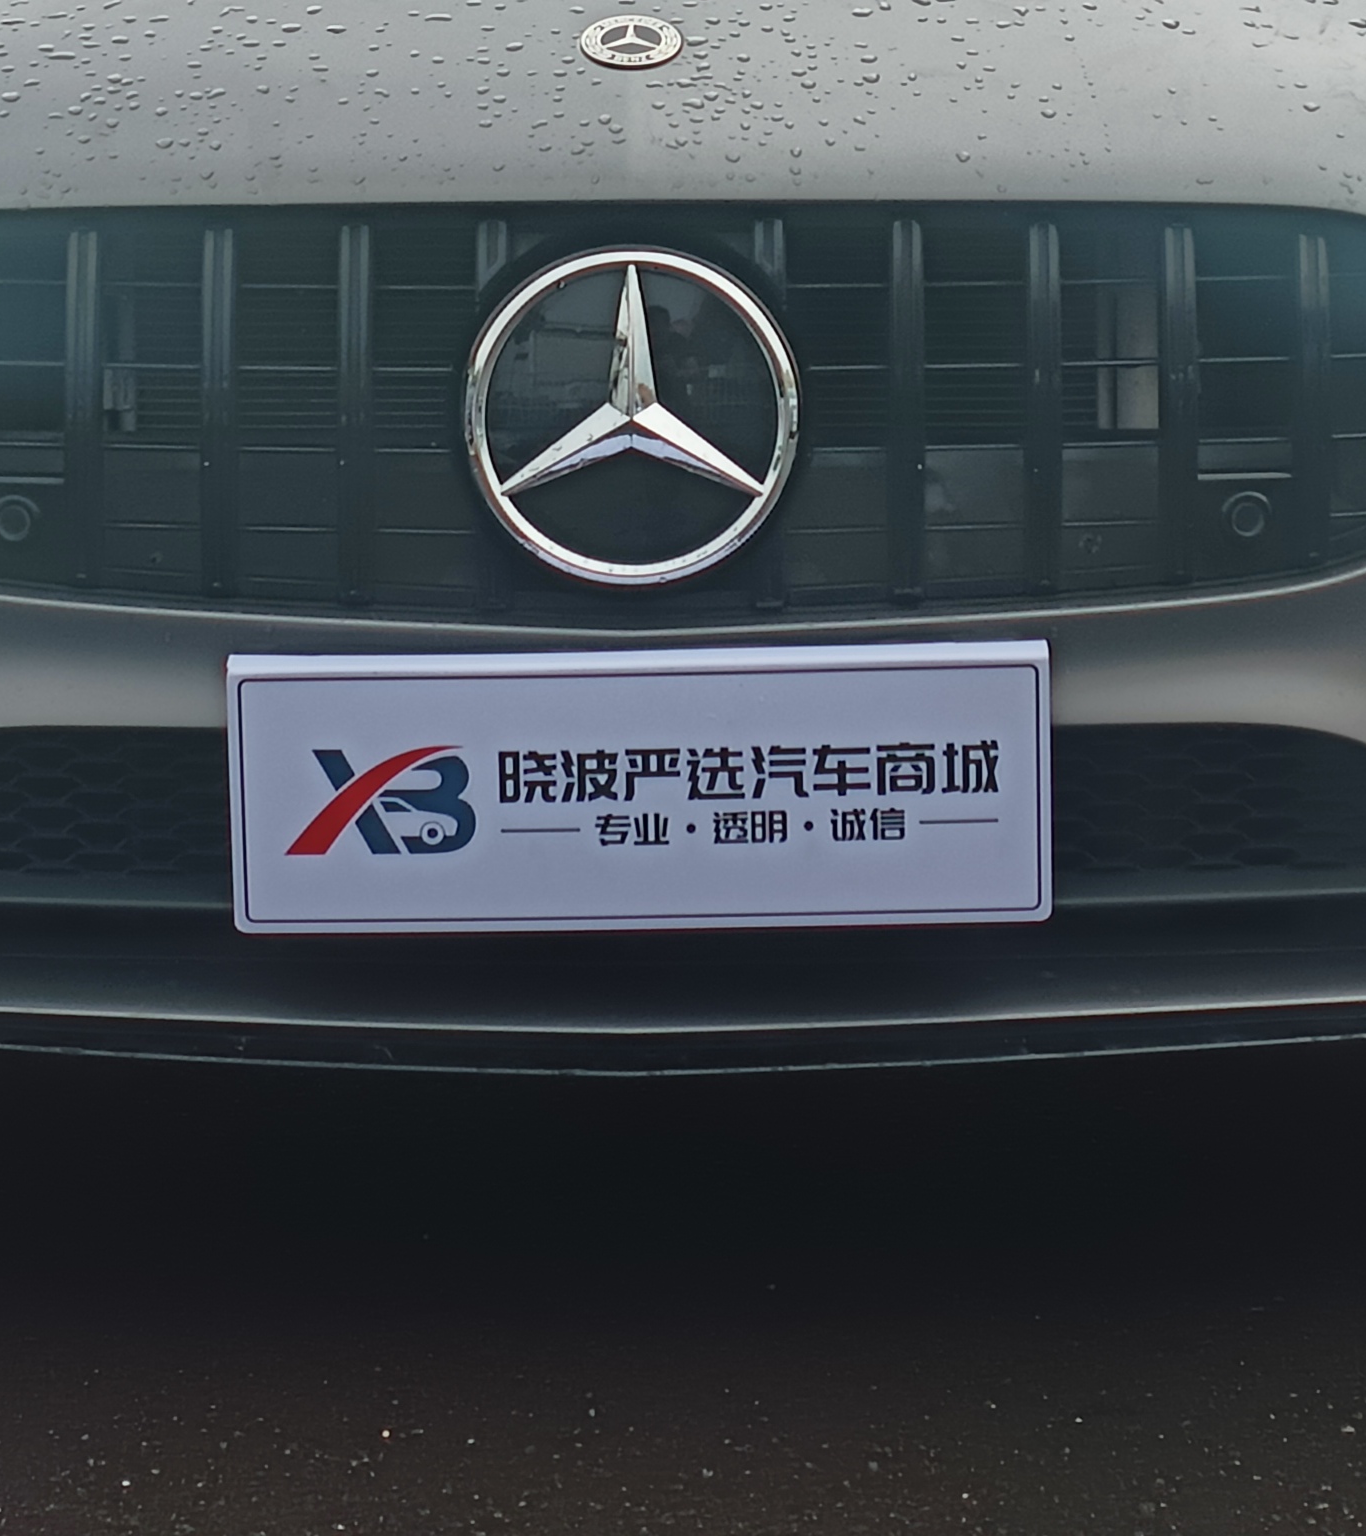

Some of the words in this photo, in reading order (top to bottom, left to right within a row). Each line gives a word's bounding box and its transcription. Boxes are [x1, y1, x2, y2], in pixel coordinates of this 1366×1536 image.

[498, 739, 999, 805] 晓波严选汽车商城
